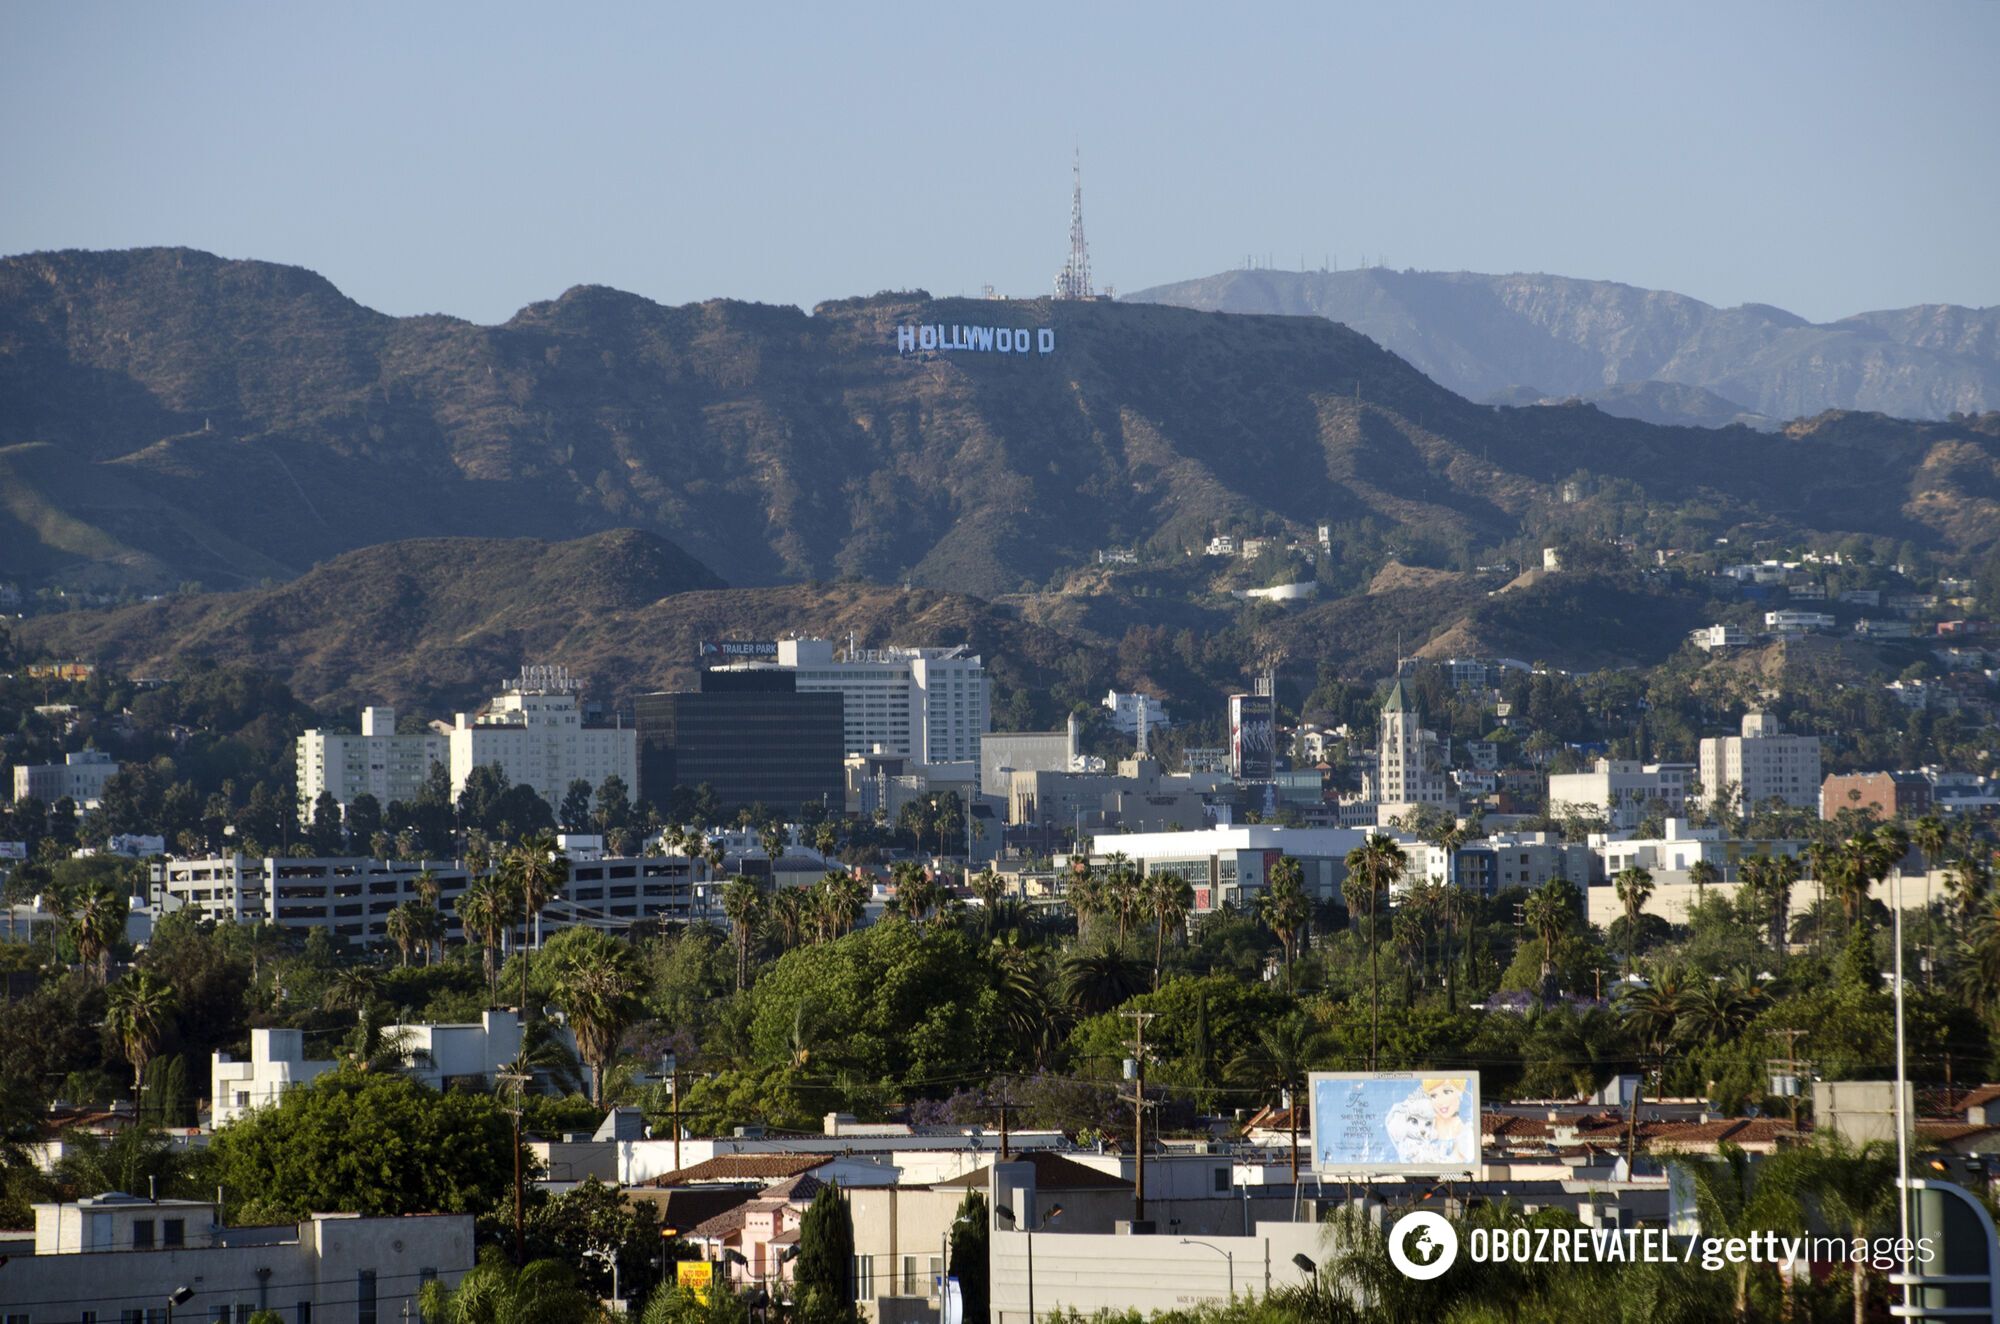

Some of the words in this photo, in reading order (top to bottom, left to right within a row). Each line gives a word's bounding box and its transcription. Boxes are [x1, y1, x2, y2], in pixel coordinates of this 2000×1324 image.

[898, 324, 1055, 353] HOLLYWOOD
[721, 643, 754, 654] TRAILER
[755, 643, 777, 654] PARK
